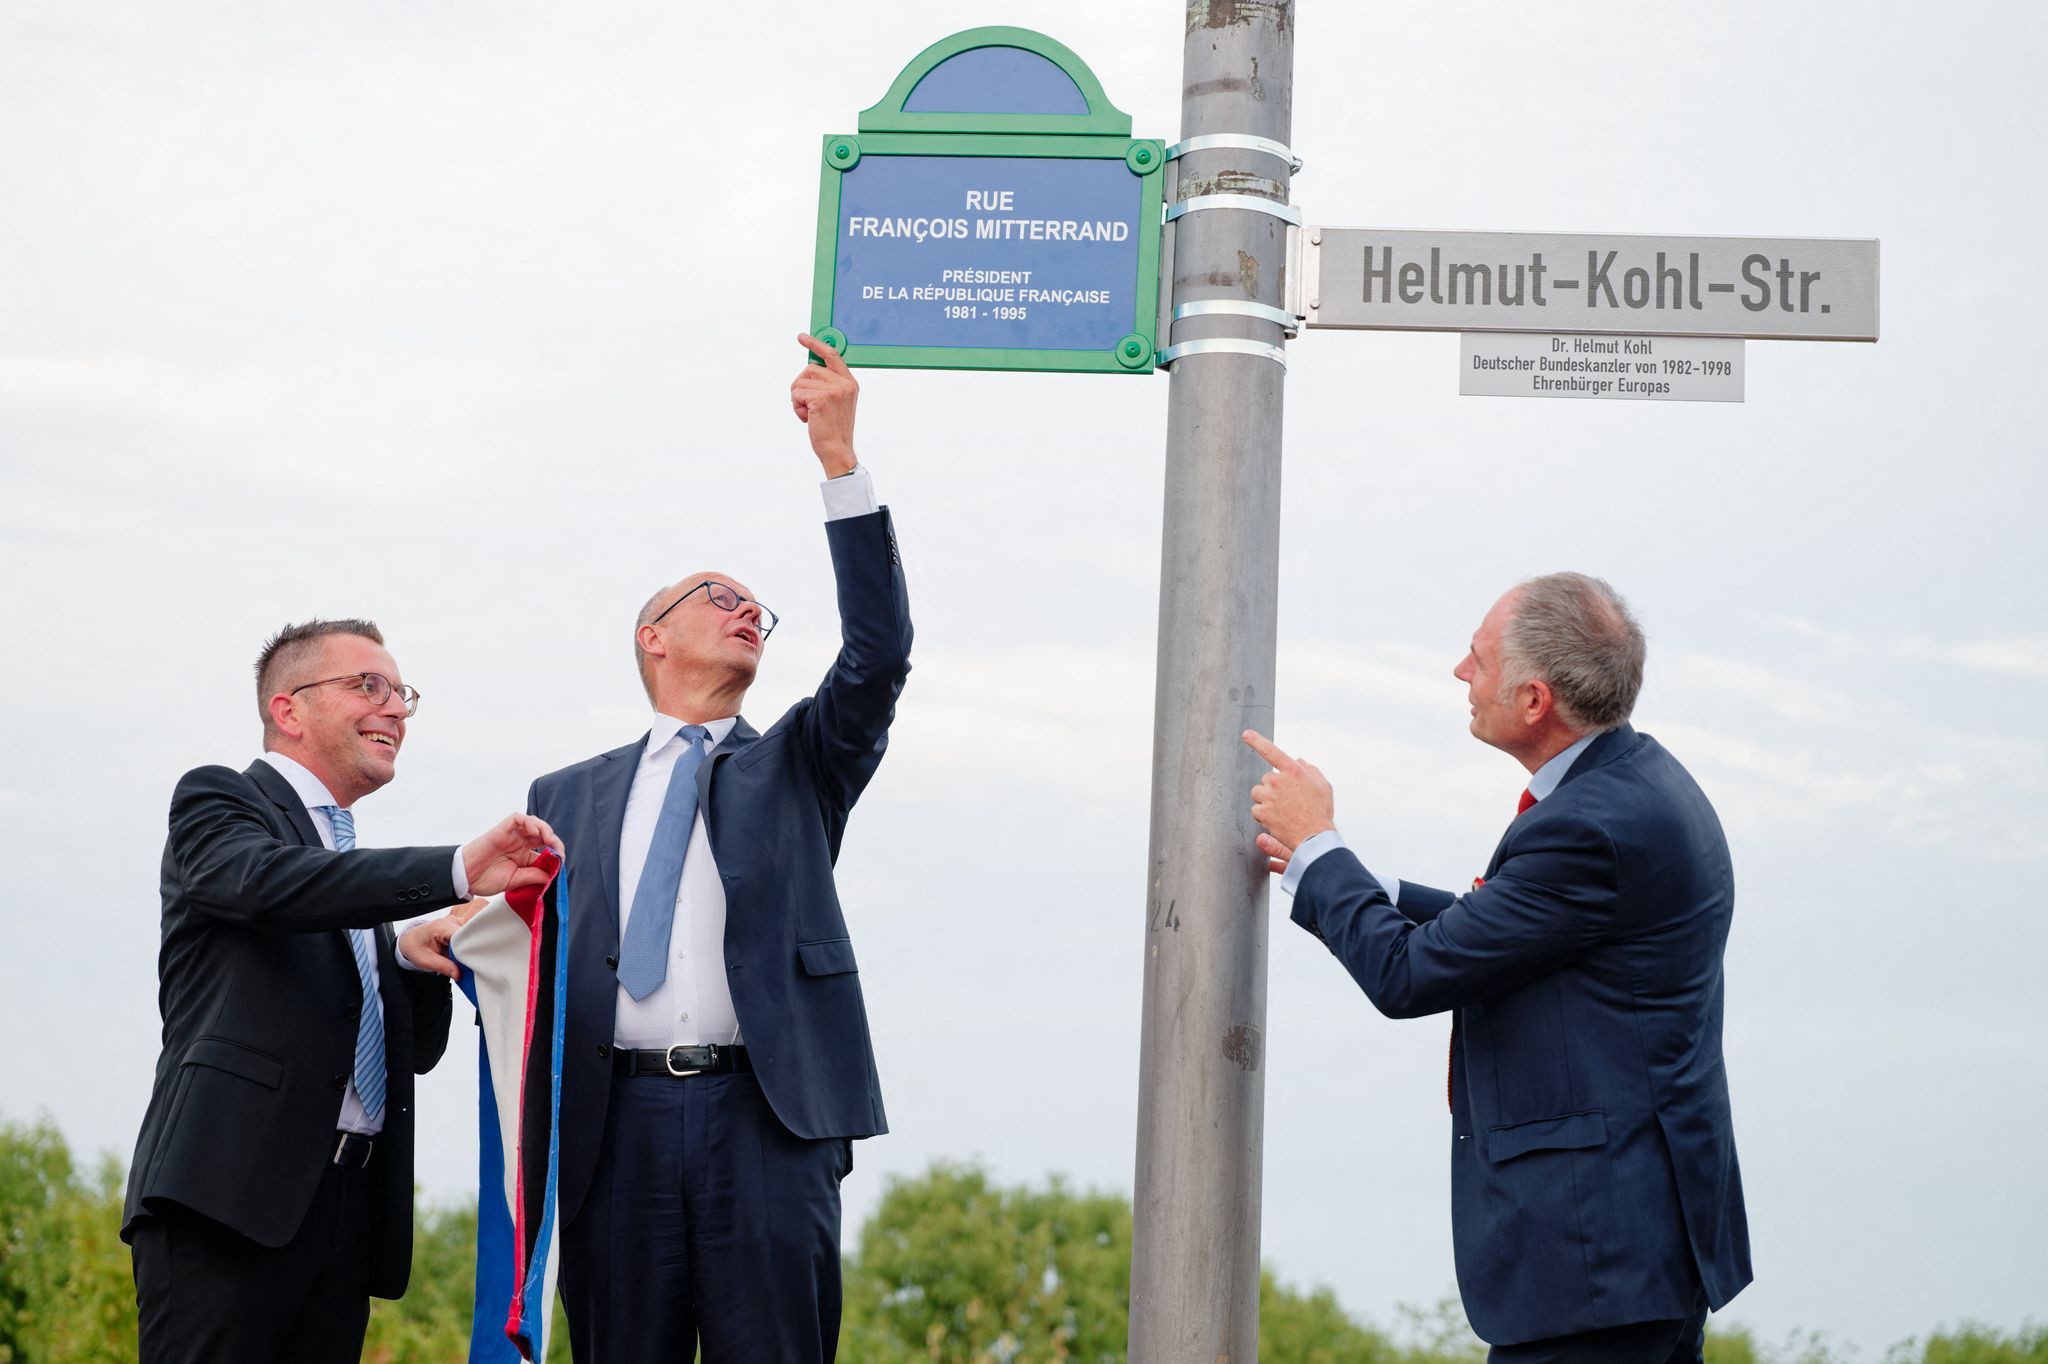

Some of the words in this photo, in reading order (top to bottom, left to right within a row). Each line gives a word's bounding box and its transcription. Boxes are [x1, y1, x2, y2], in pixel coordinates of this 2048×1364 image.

[966, 190, 1014, 211] RUE
[849, 217, 969, 243] FRANÇOIS
[976, 219, 1129, 242] MITTERRAND
[942, 267, 1031, 285] PRÉSIDENT
[1363, 245, 1831, 314] Helmut-Kohl-Str.
[862, 286, 884, 300] DE
[888, 286, 909, 301] LA
[913, 284, 1014, 303] RÉPUBLIQUE
[1019, 289, 1110, 306] FRANÇAISE
[943, 306, 977, 320] 1981
[992, 307, 1027, 321] 1995
[1552, 338, 1569, 353] Dr.
[1574, 338, 1619, 354] Helmut
[1624, 340, 1653, 355] Kohl
[1473, 355, 1535, 371] Deutscher
[1540, 357, 1631, 374] Bundeskanzler
[1635, 363, 1657, 374] von
[1662, 360, 1732, 376] 1982-1998
[1533, 375, 1613, 395] Ehrenbürger
[1618, 378, 1670, 396] Europas
